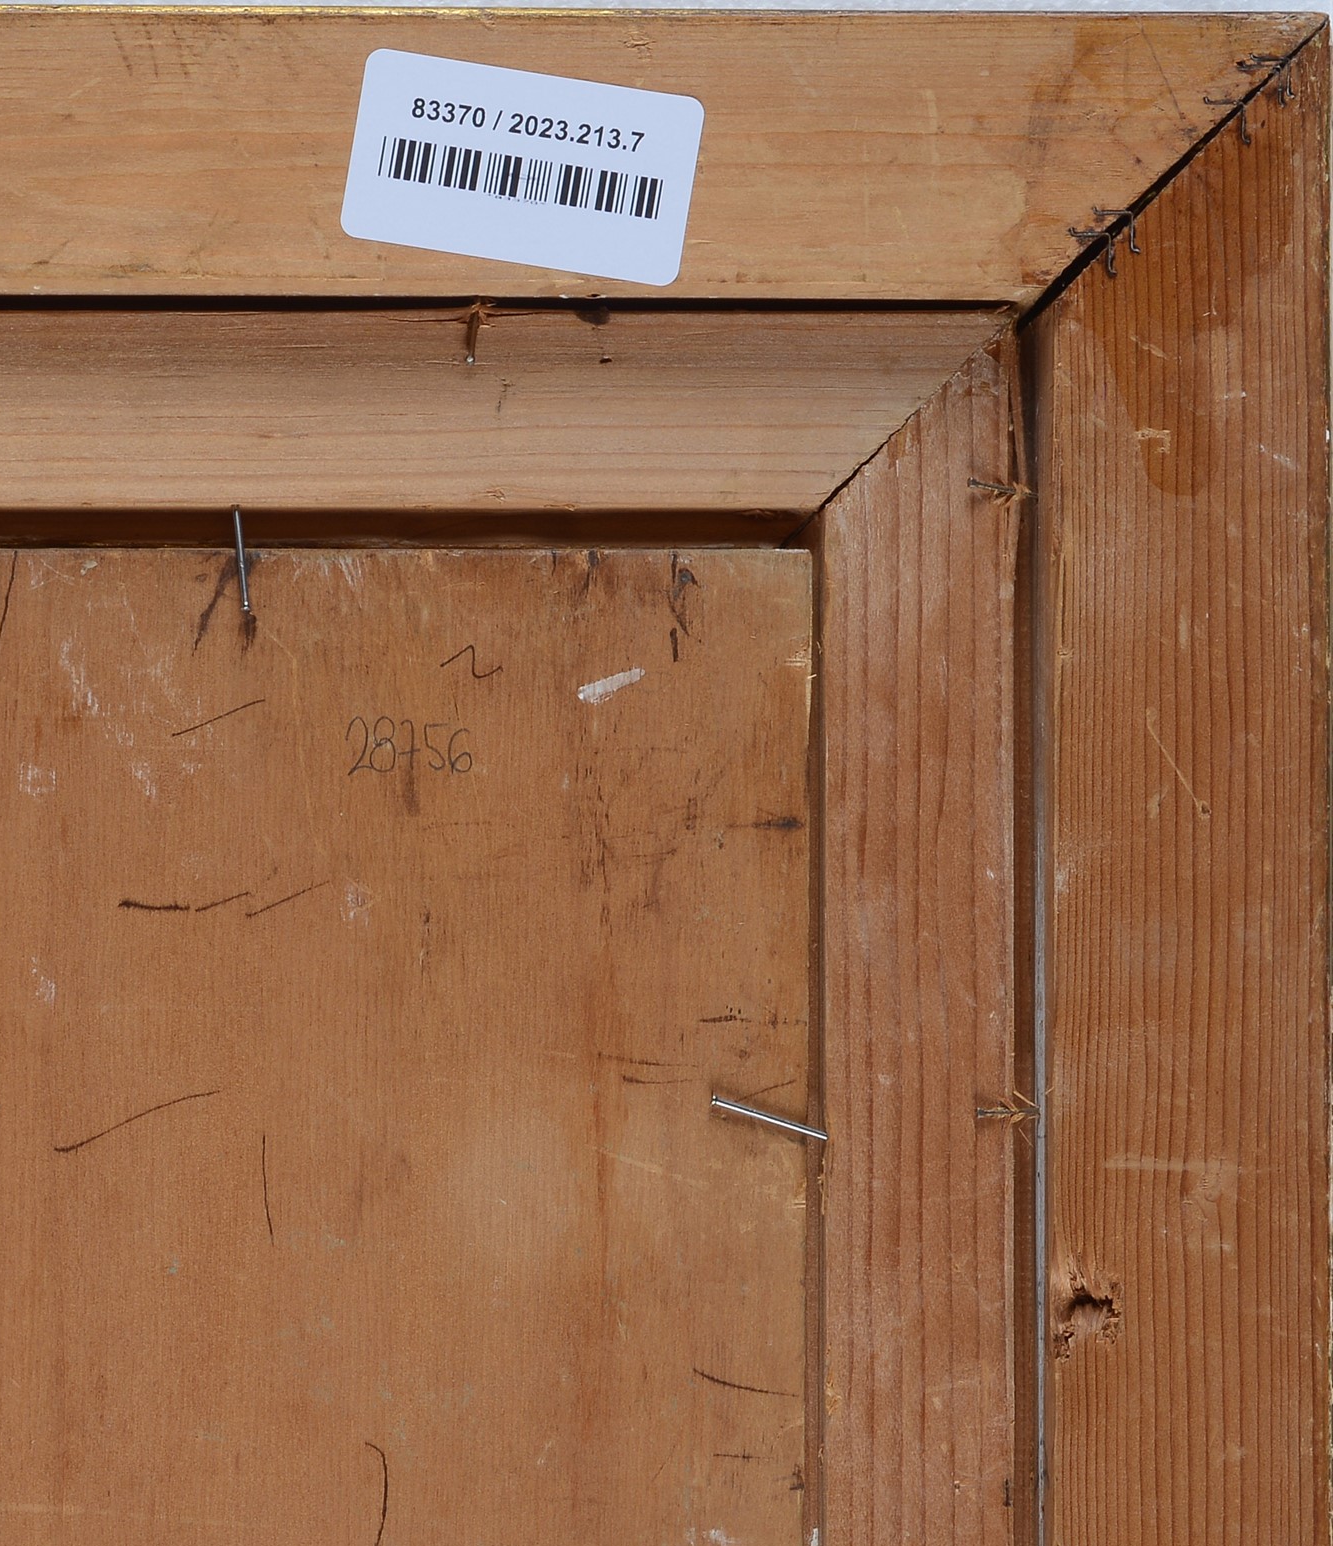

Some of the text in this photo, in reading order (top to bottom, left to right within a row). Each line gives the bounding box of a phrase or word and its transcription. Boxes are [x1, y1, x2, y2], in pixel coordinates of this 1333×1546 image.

[411, 98, 645, 153] 83370 / 2023.213.7
[344, 715, 473, 776] 28756
